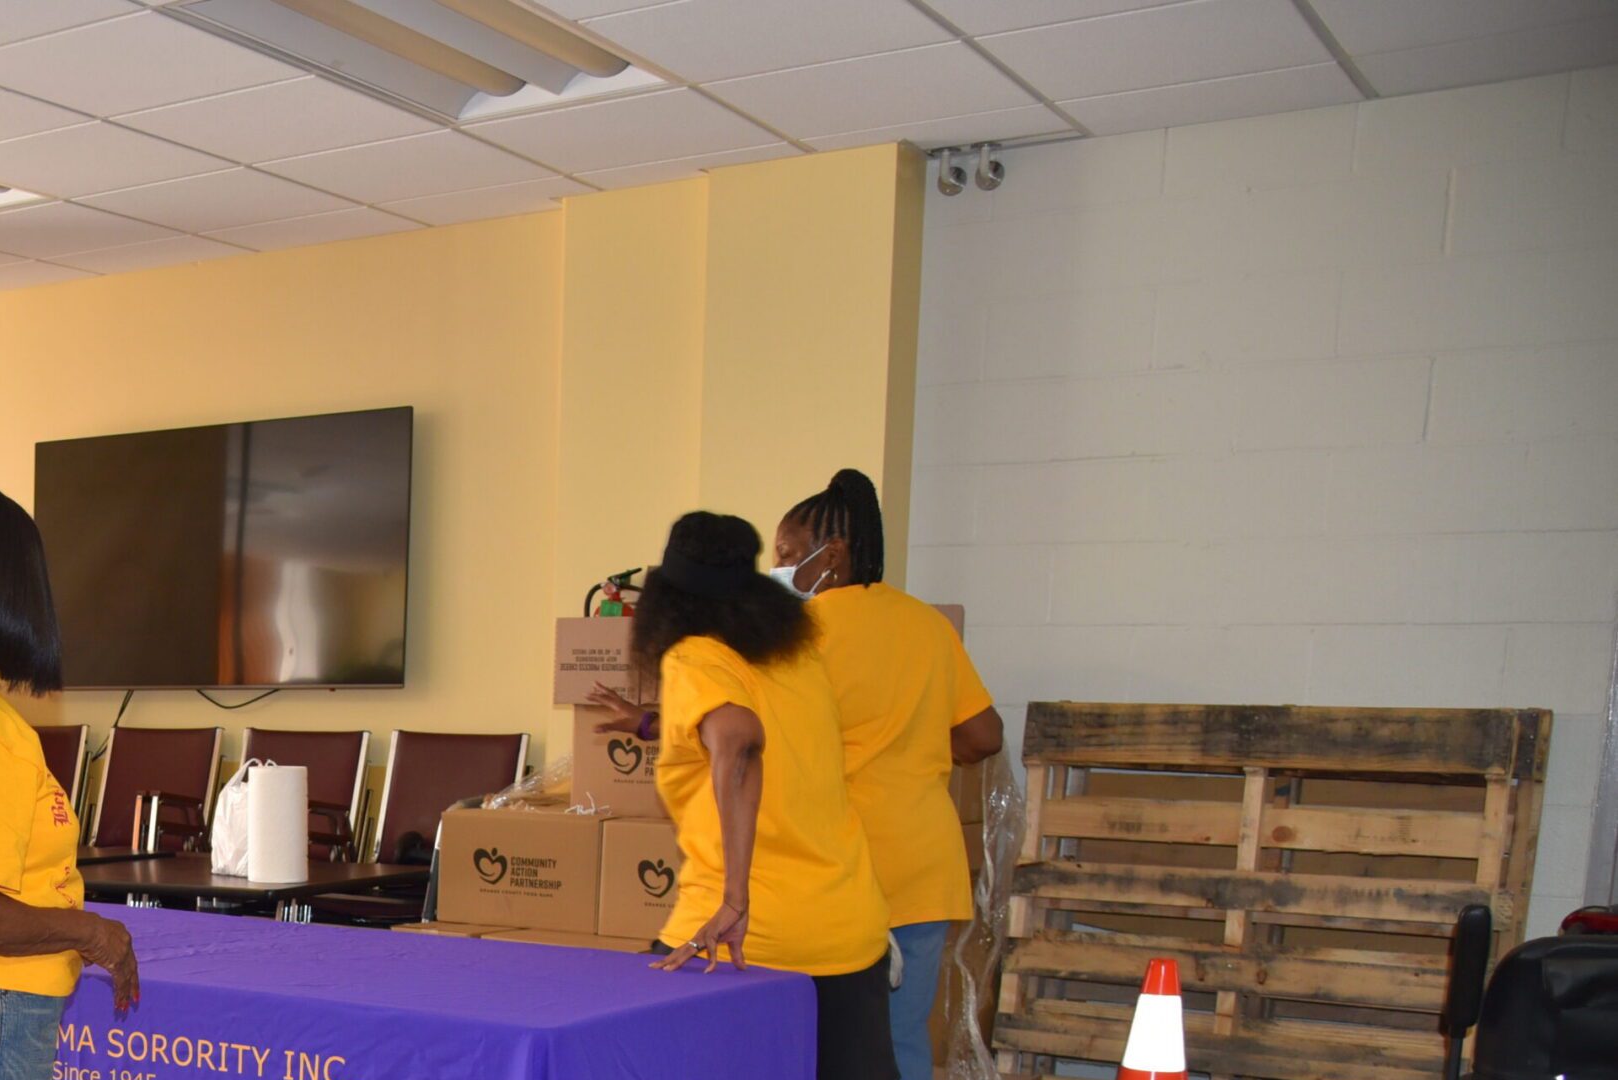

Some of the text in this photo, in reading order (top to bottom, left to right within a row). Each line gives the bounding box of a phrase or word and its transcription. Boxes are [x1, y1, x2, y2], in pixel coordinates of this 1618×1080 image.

[510, 856, 557, 869] COMMUNITY
[510, 867, 538, 878] ACTION
[509, 877, 562, 890] PARTNERSHIP
[55, 1023, 96, 1055] MA
[107, 1028, 270, 1077] SORORITY
